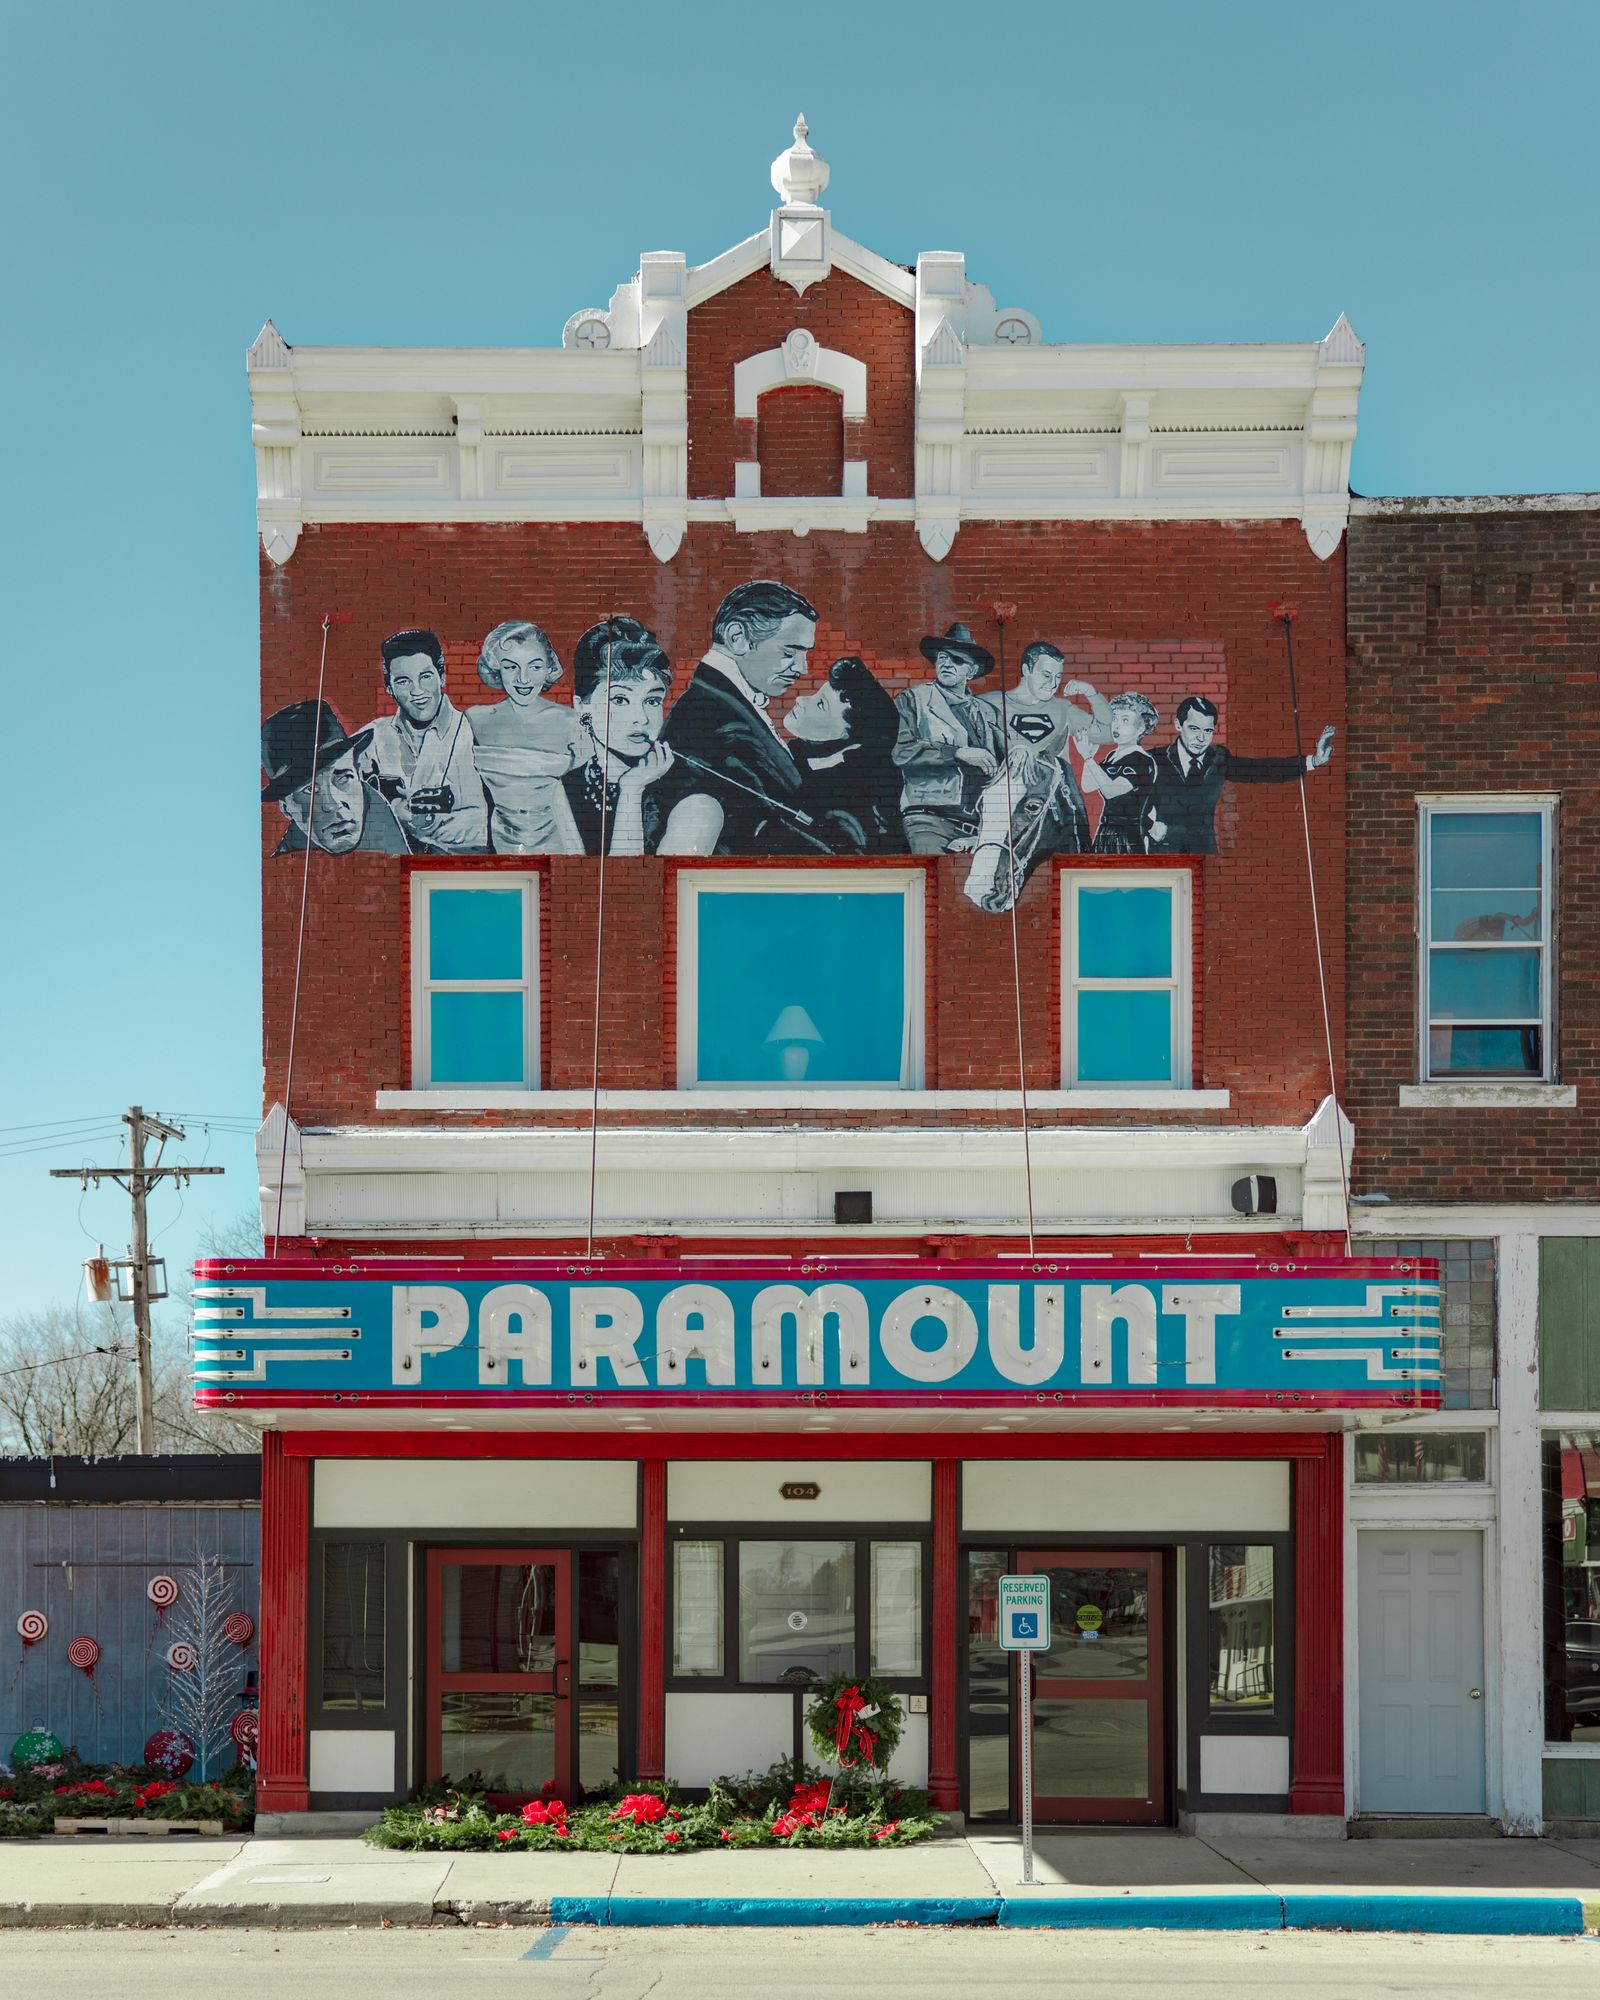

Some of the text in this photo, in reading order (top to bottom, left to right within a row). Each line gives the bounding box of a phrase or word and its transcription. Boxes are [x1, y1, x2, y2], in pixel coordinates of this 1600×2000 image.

[392, 1283, 1241, 1386] PARAMOUNT
[786, 1487, 815, 1496] 104
[1003, 1583, 1046, 1593] RESERVED
[1006, 1595, 1043, 1605] PARKING
